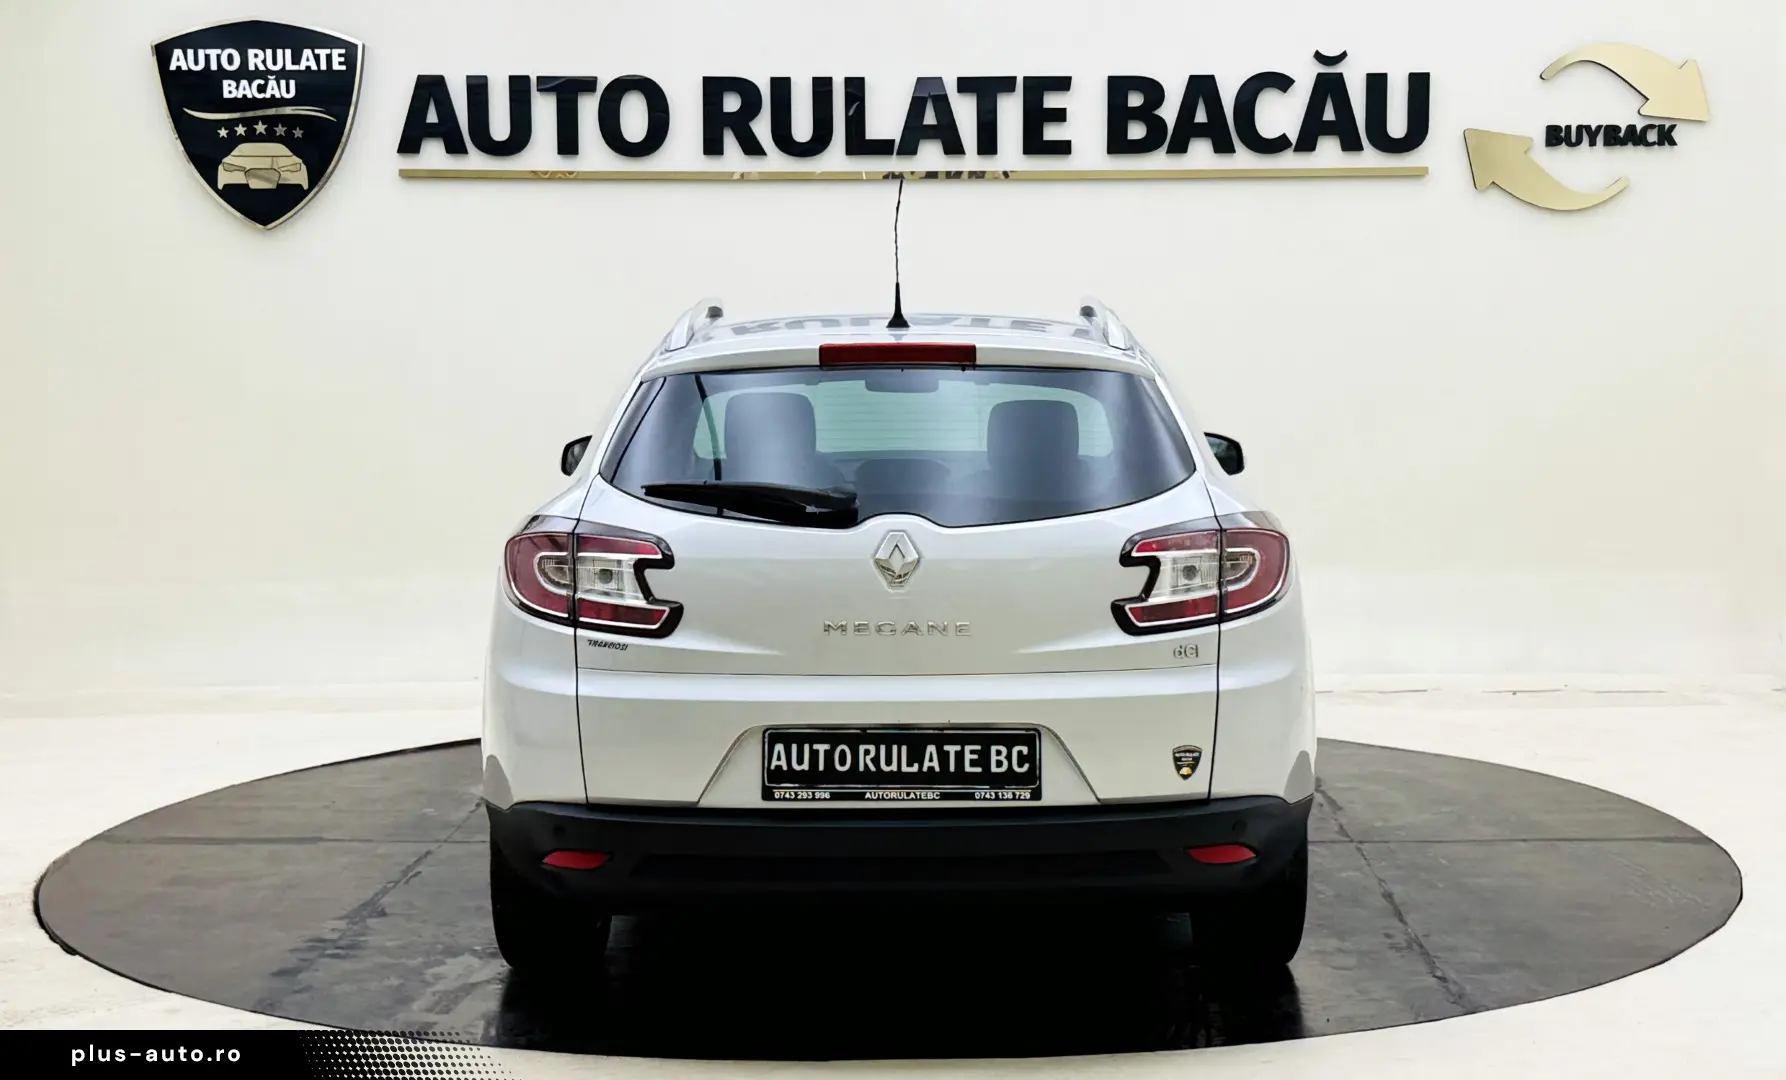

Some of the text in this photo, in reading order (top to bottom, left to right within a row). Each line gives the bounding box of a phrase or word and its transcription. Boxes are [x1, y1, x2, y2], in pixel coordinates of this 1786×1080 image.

[169, 47, 347, 72] AUTO RULATE
[222, 74, 296, 100] BACĂU
[397, 49, 1431, 158] AUTO RULATE BACĂU
[1544, 123, 1678, 149] BUYBACK
[823, 619, 972, 637] MEGANE
[770, 743, 1030, 773] AUTO RULATE BC
[774, 791, 795, 799] 0743
[797, 791, 812, 799] 293
[864, 791, 940, 800] AUTORULATEBC
[974, 791, 996, 800] 0743
[1014, 791, 1031, 800] 729
